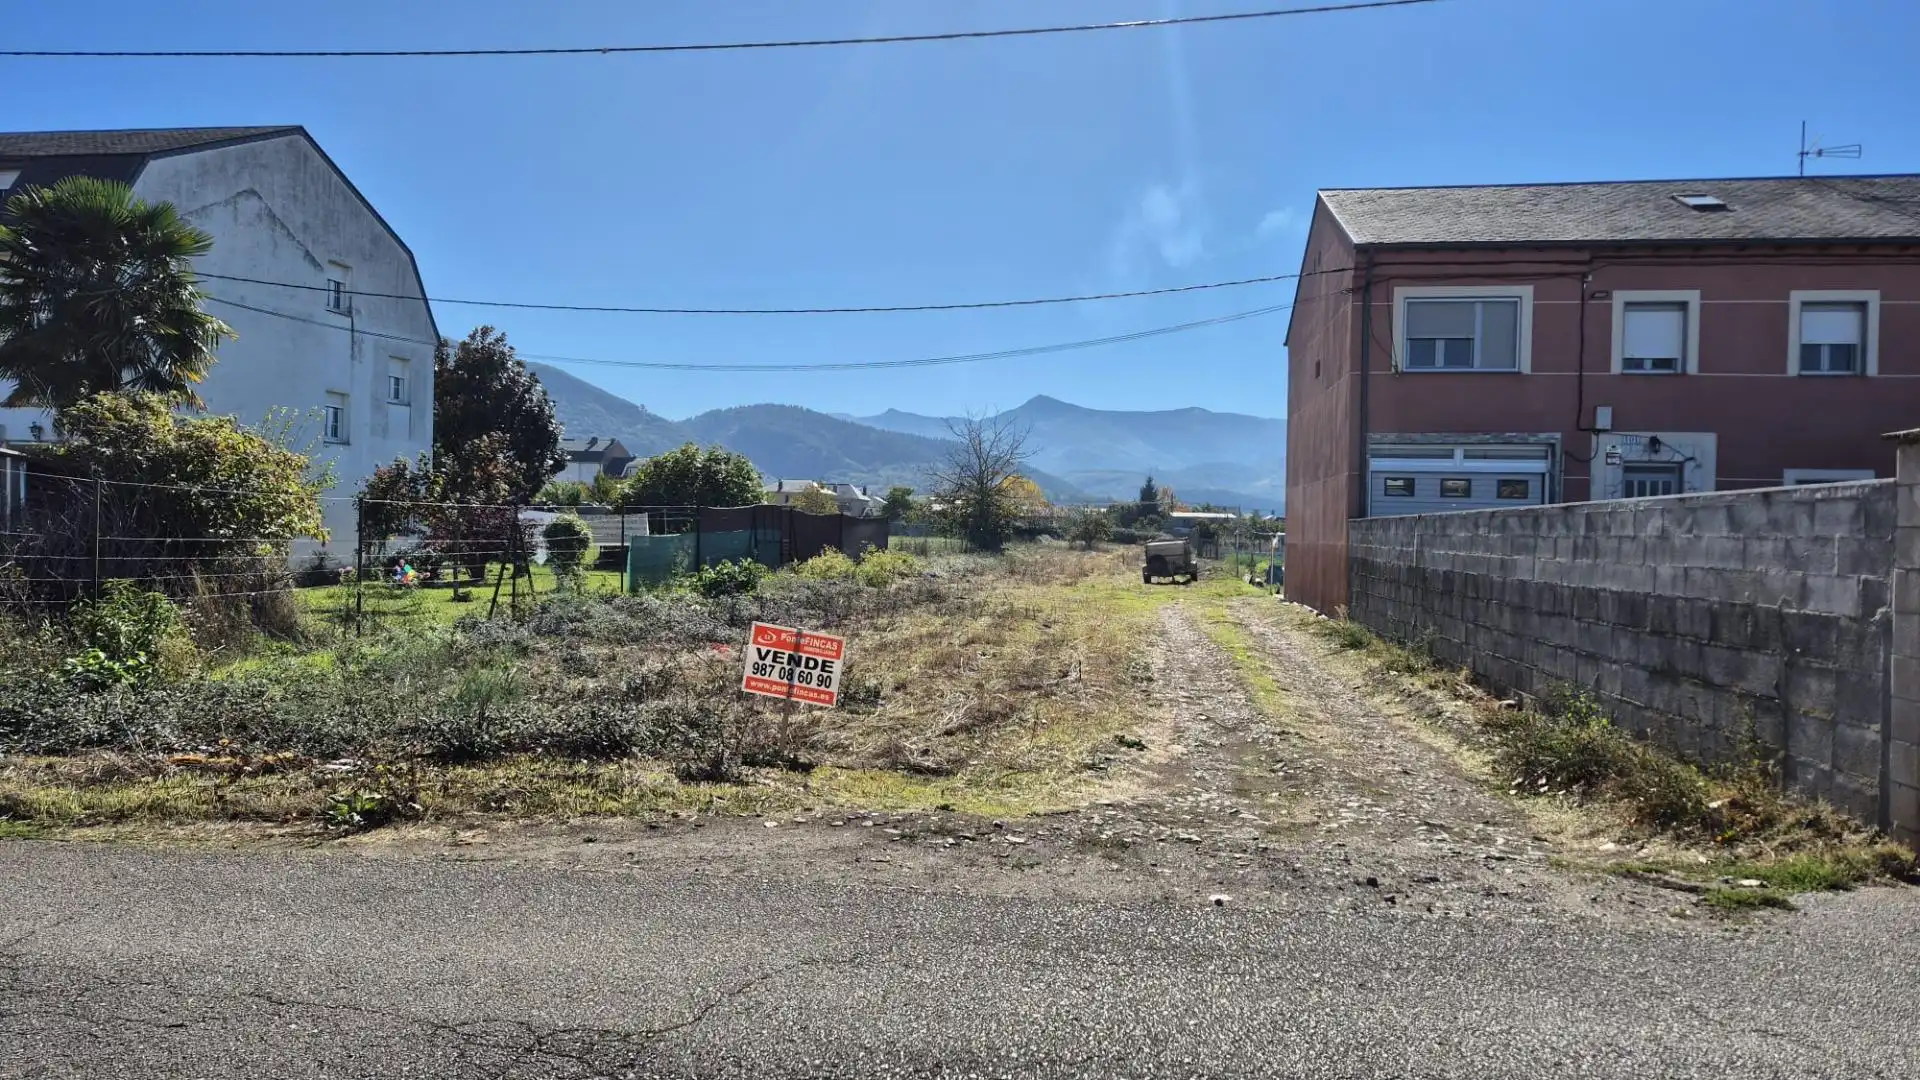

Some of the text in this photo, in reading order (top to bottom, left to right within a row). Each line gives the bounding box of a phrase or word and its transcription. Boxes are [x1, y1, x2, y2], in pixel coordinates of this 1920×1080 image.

[756, 647, 835, 674] VENDE
[752, 662, 832, 689] 987 08 60 90
